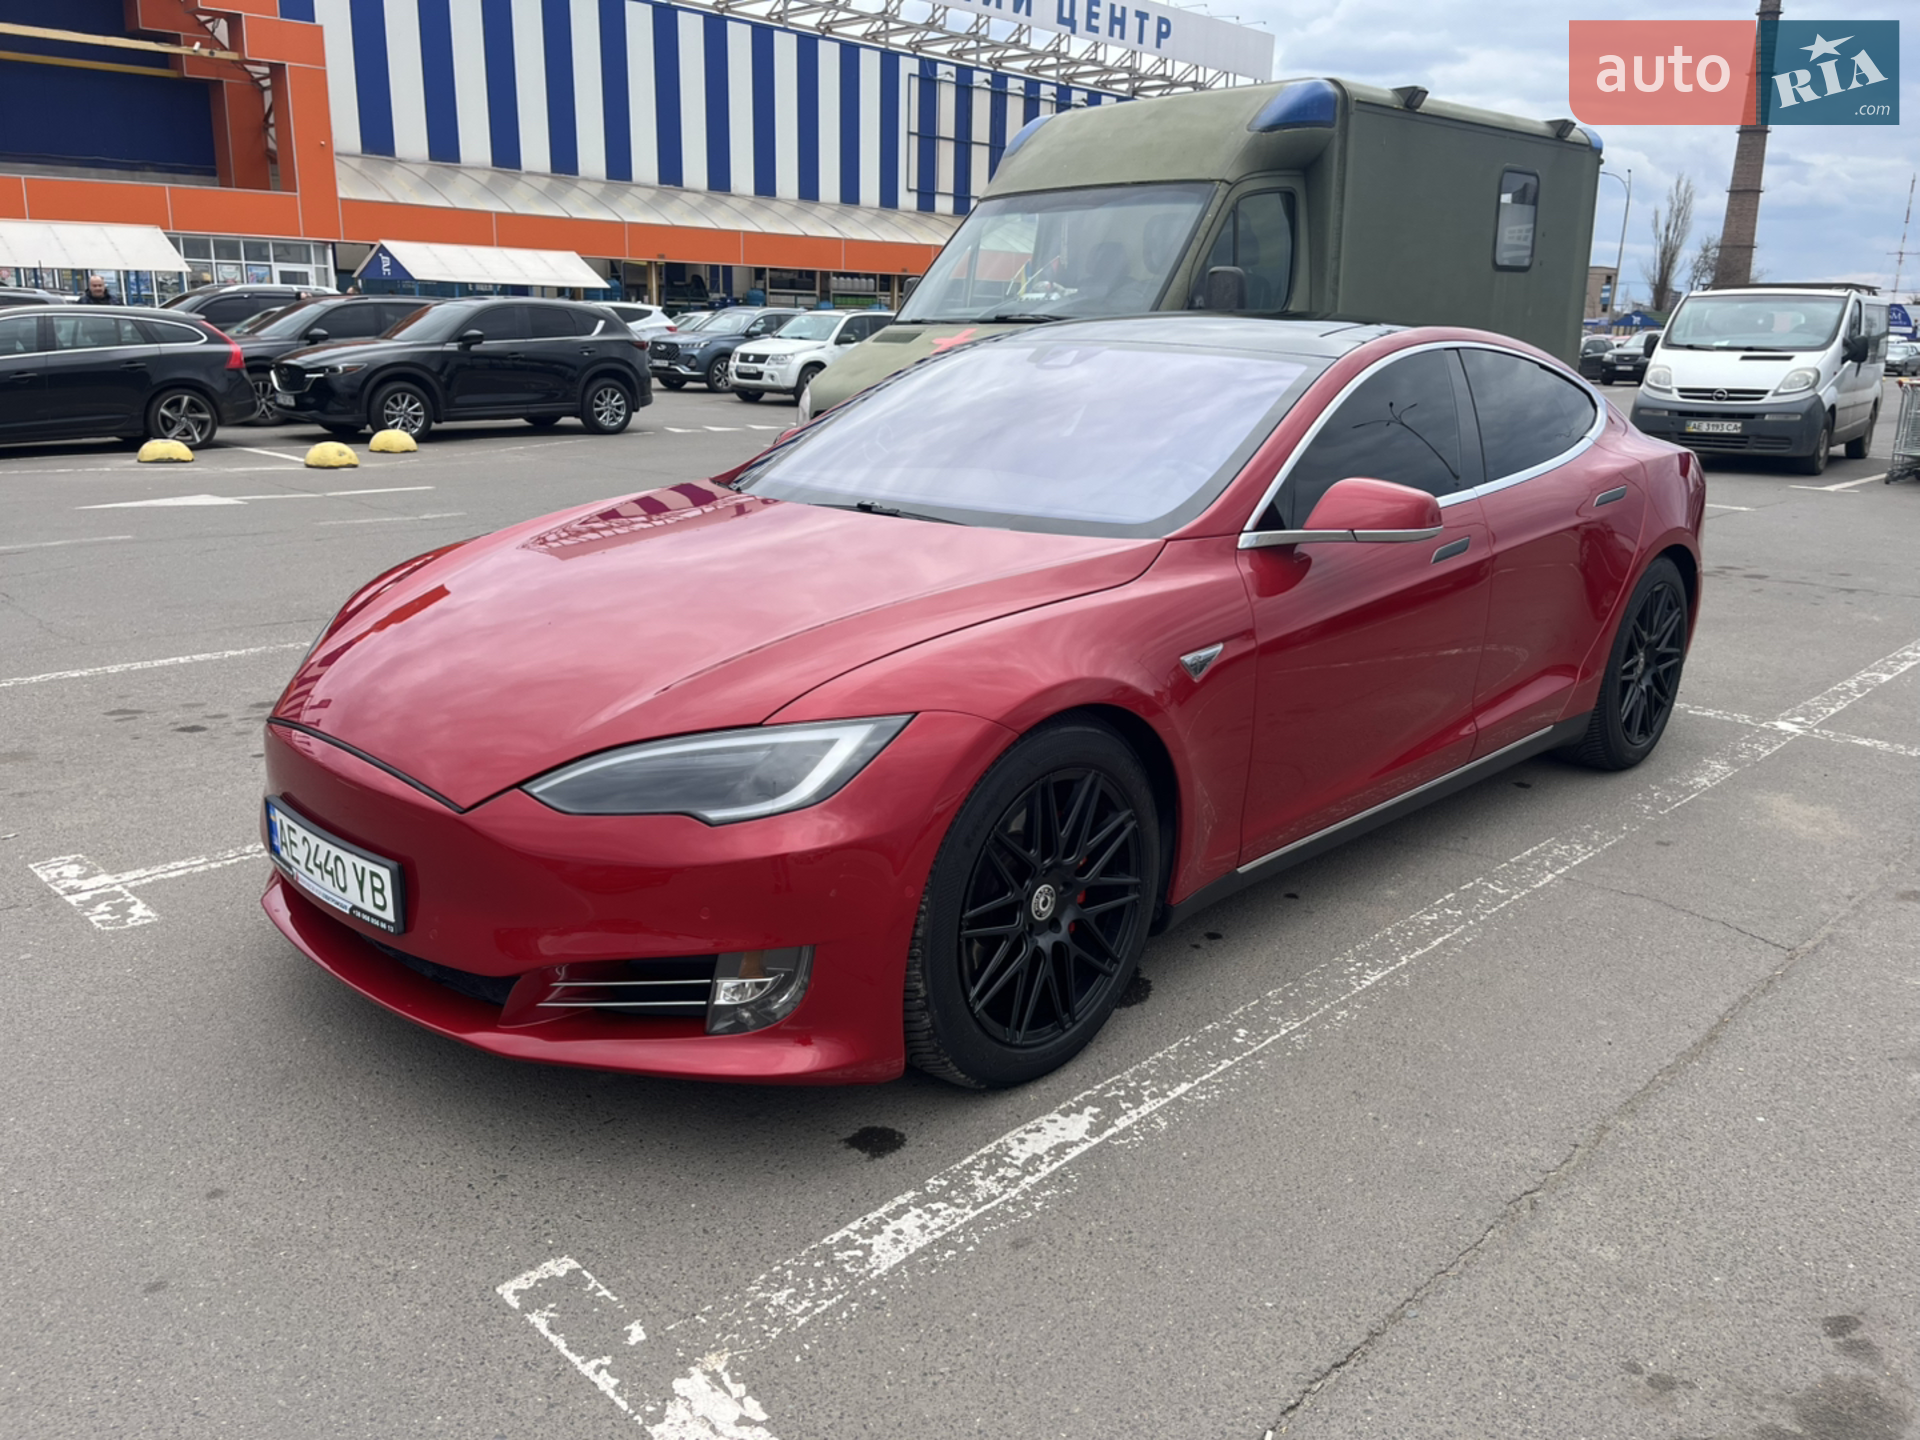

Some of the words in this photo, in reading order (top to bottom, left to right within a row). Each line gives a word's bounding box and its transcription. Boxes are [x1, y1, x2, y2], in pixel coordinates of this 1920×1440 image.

[1056, 0, 1172, 49] ЦЕНТР
[279, 818, 301, 867] AE
[302, 835, 348, 894] 2440
[352, 861, 388, 912] YB
